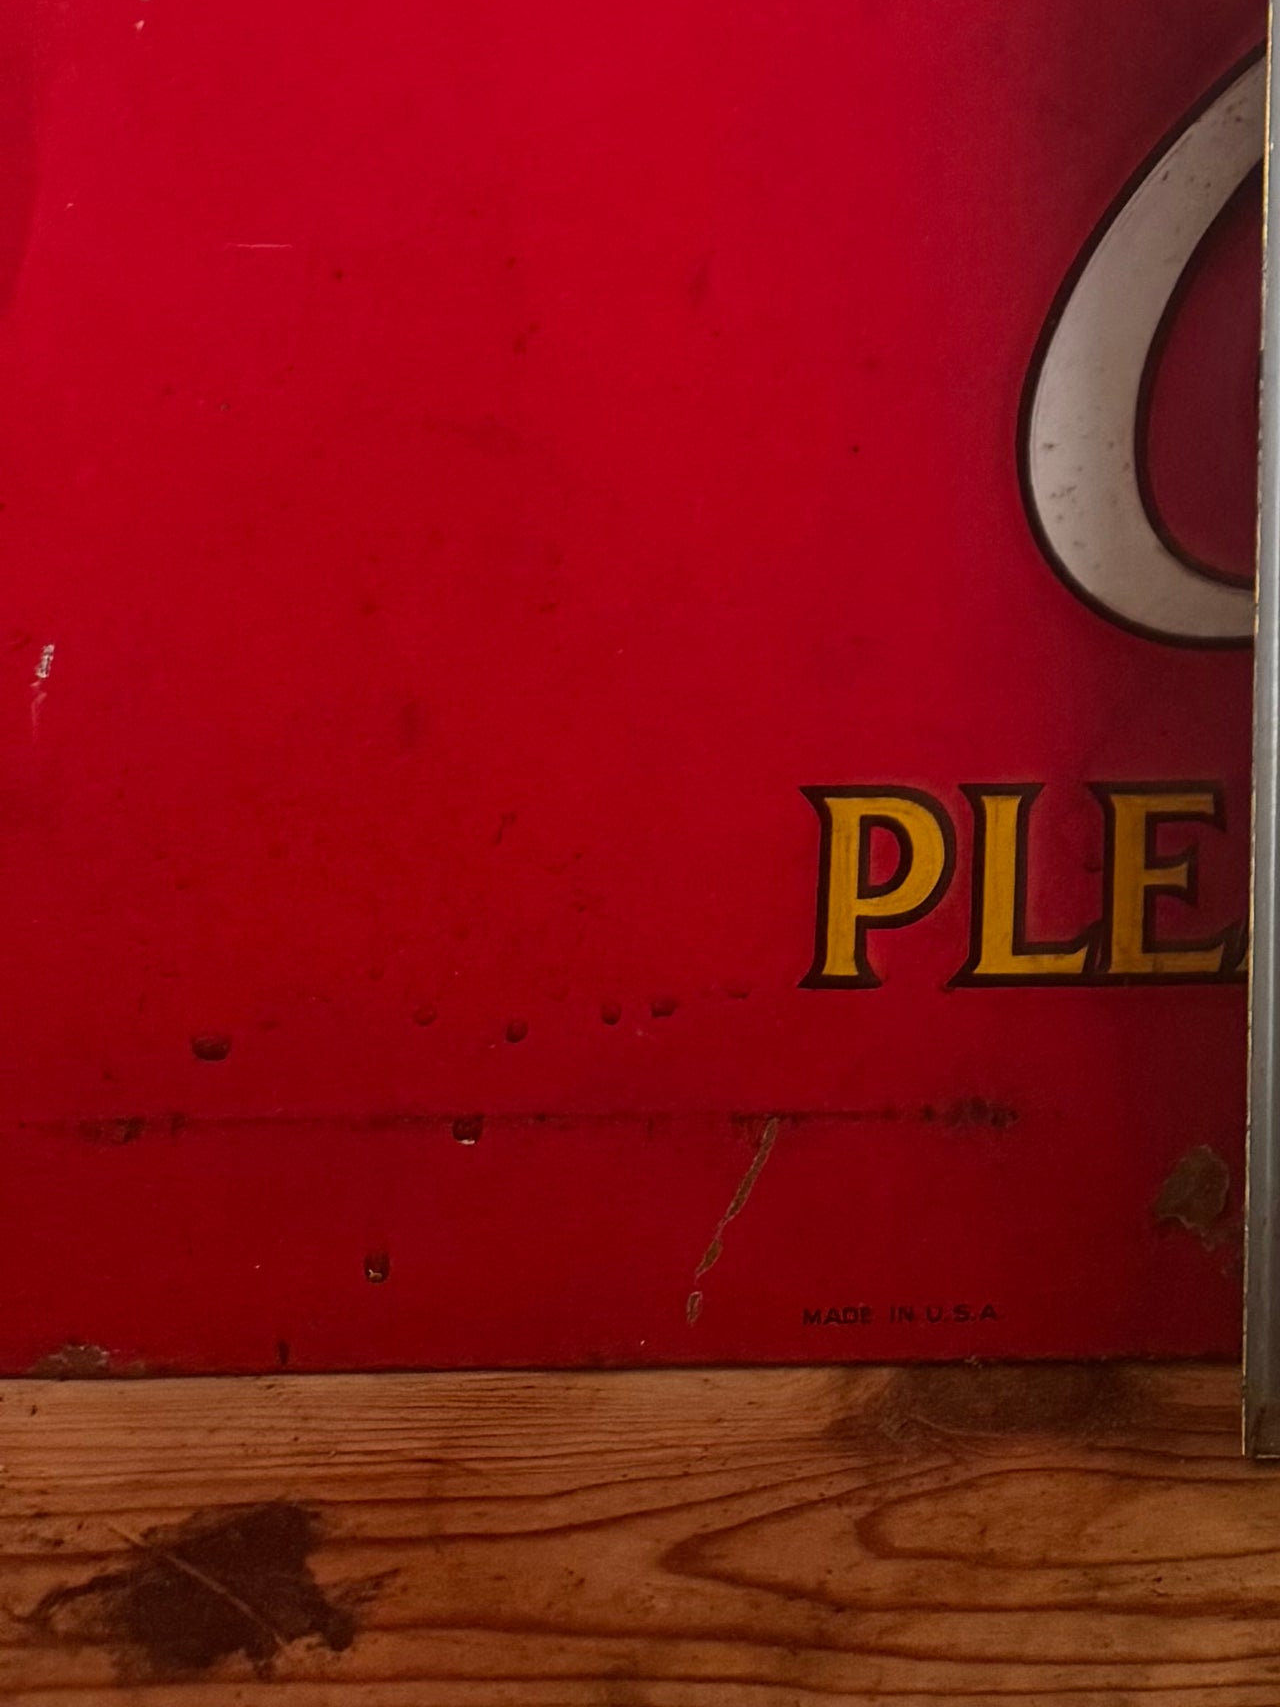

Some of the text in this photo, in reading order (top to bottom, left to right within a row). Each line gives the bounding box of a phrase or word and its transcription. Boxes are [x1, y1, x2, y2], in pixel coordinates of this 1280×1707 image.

[798, 780, 1248, 989] PLE
[802, 1305, 873, 1327] MADE
[889, 1304, 915, 1325] IN
